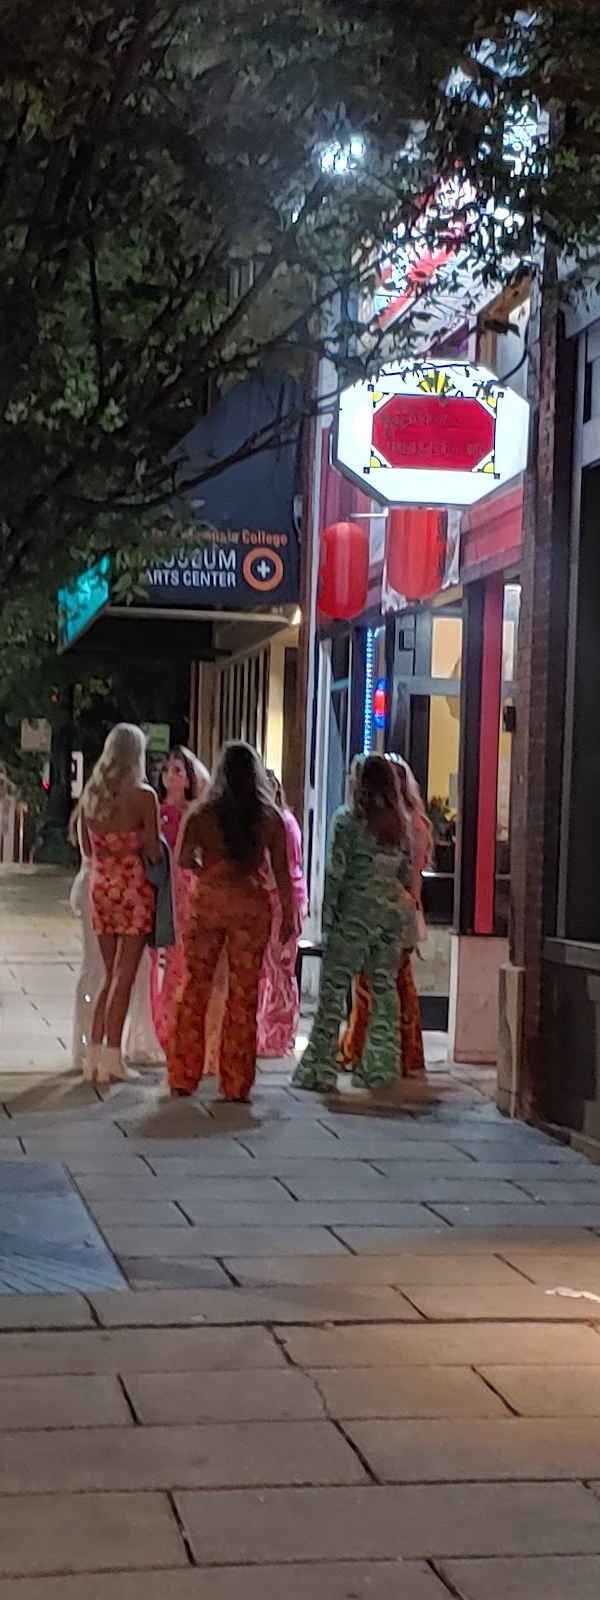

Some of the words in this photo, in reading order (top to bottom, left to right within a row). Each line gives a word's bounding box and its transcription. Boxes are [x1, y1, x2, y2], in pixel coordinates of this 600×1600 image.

[241, 528, 289, 548] College
[144, 568, 180, 586] ARTS
[182, 569, 236, 588] CENTER
